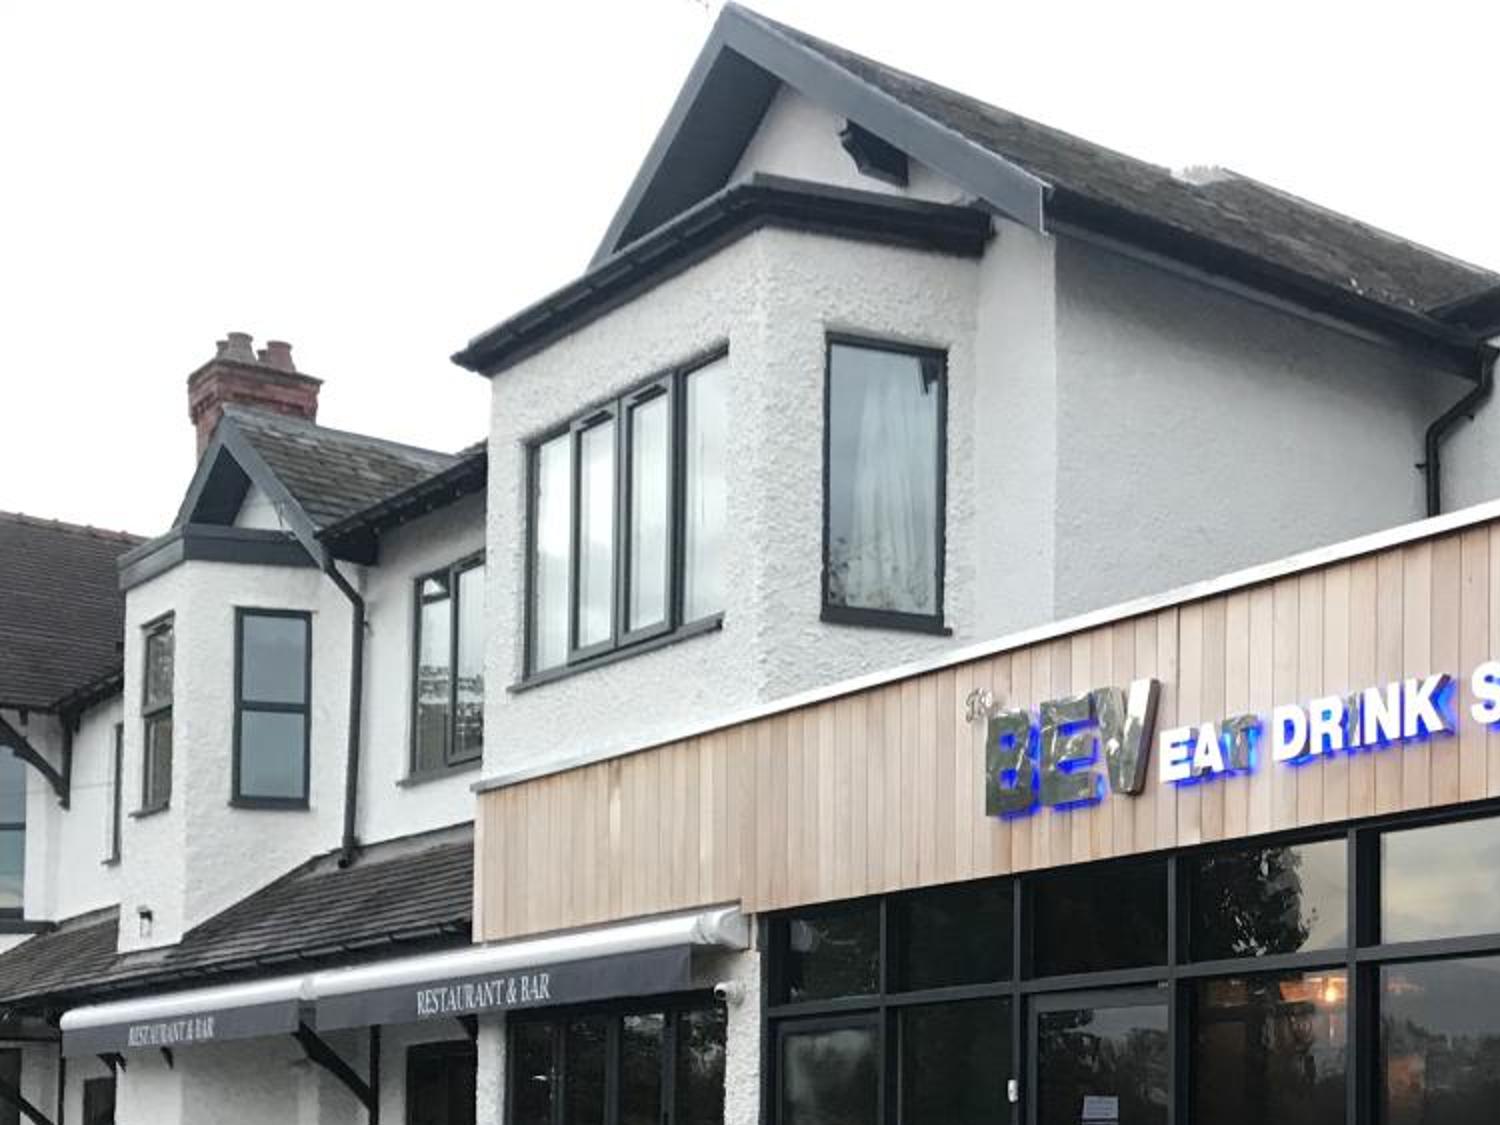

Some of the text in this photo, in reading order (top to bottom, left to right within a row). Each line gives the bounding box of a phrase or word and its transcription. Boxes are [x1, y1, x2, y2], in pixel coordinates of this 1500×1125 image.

[986, 678, 1160, 817] BEV
[1159, 714, 1260, 784] EAT
[1272, 675, 1452, 762] DRINK
[417, 973, 550, 1015] RESTAURANT & BAR
